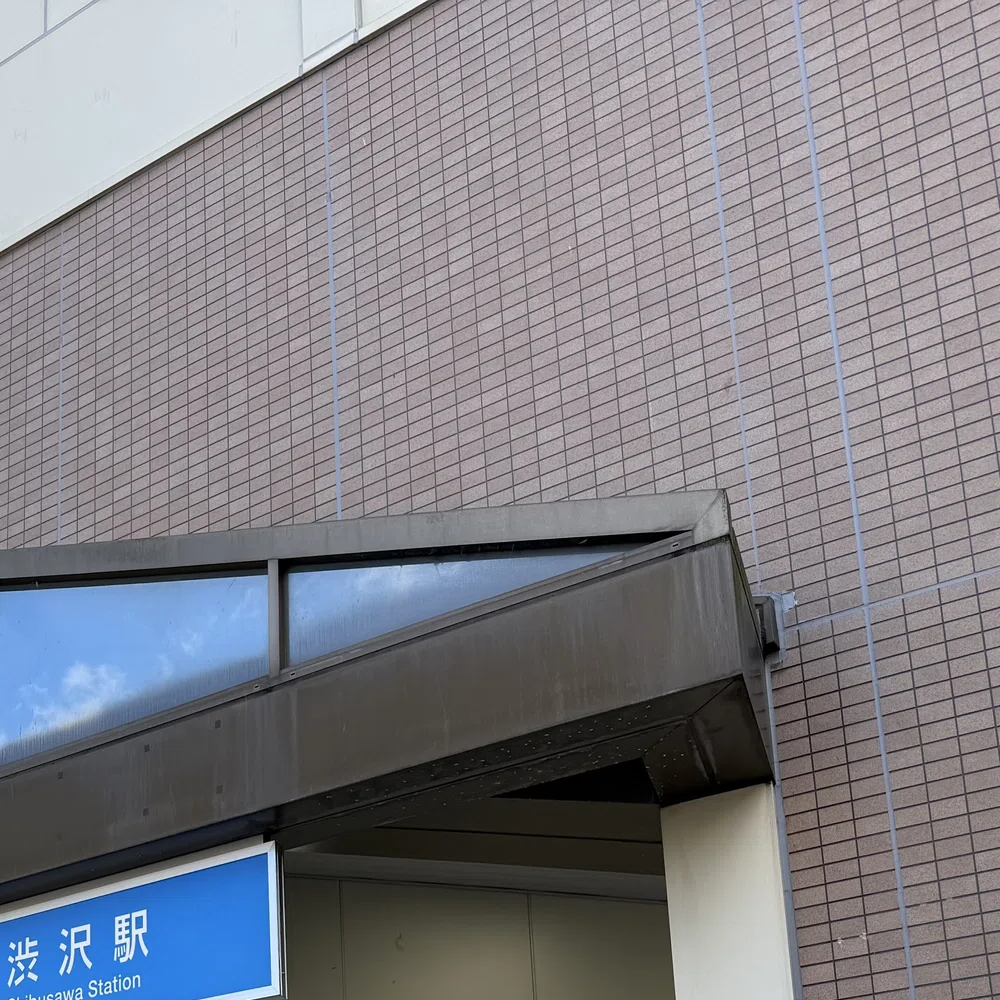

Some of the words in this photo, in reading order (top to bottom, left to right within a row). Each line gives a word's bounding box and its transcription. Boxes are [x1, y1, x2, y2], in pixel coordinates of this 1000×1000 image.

[7, 908, 149, 988] 渋沢駅
[88, 974, 141, 998] Station
